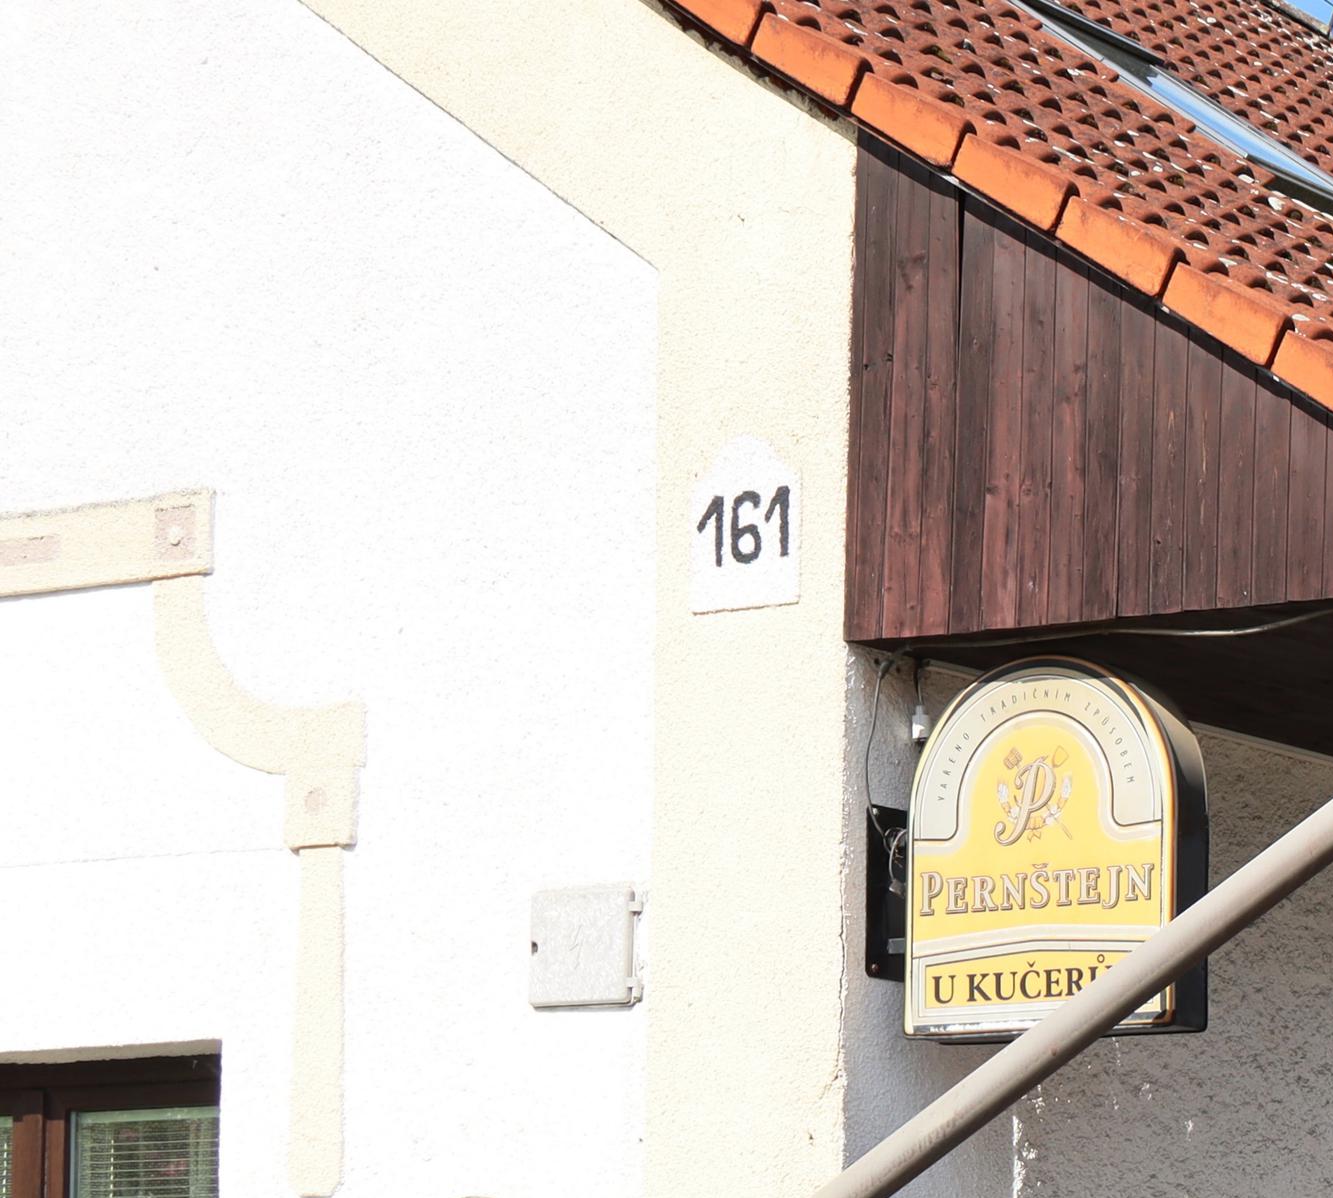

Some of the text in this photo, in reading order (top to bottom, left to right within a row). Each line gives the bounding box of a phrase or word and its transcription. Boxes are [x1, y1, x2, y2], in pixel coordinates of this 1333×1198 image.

[697, 485, 791, 567] 161
[919, 863, 1155, 916] PERNŠTEJN
[932, 974, 955, 1004] U
